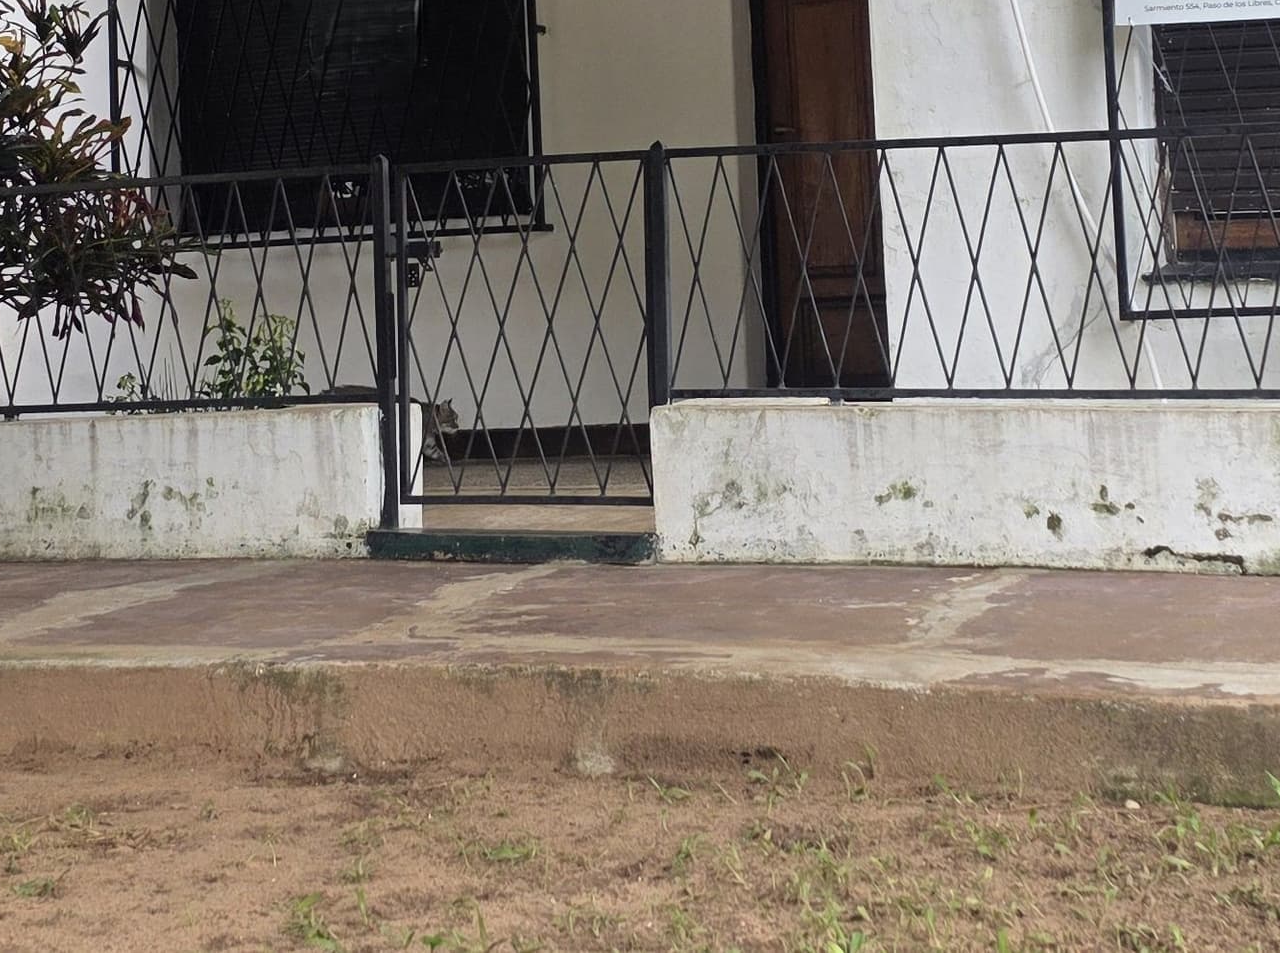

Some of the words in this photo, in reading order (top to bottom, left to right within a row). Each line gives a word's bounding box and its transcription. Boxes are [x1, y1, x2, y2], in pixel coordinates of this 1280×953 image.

[1203, 0, 1222, 9] Paso
[1223, 0, 1234, 8] de
[1235, 0, 1247, 7] los
